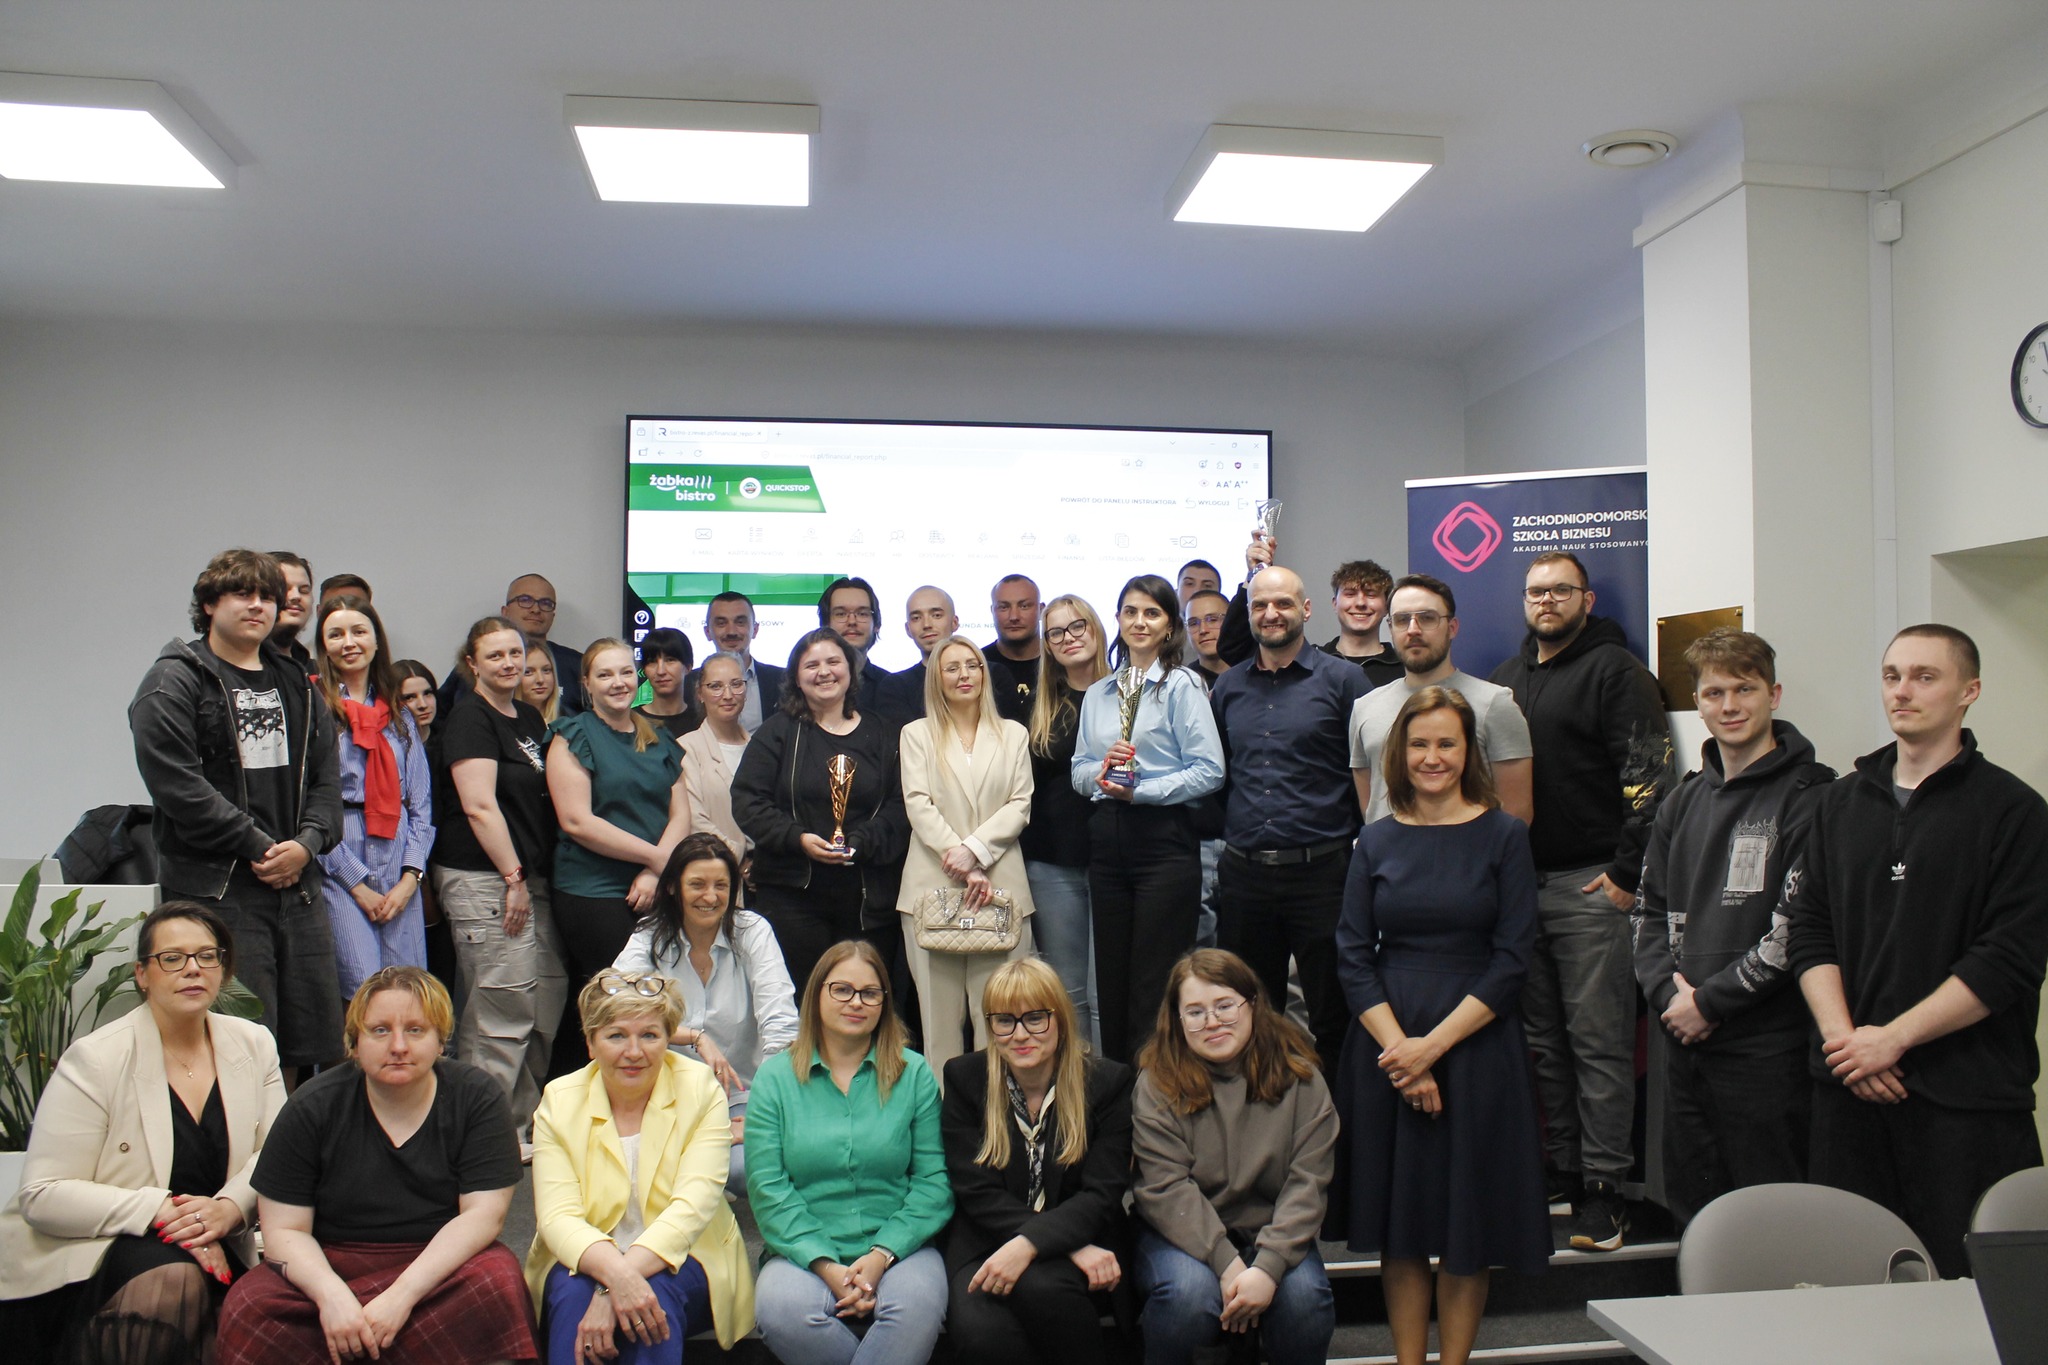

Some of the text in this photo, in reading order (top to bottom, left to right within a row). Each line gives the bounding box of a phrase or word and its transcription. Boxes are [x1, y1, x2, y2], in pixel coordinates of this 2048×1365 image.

[2024, 376, 2029, 385] 9
[2028, 395, 2033, 404] 8
[649, 474, 694, 487] żabka
[765, 484, 810, 492] QUICKSTOP
[675, 489, 716, 502] bistro
[1512, 527, 1611, 542] SZKOŁA BIZNESU
[1512, 545, 1559, 553] AKADEMIA
[1562, 543, 1586, 551] NAUK
